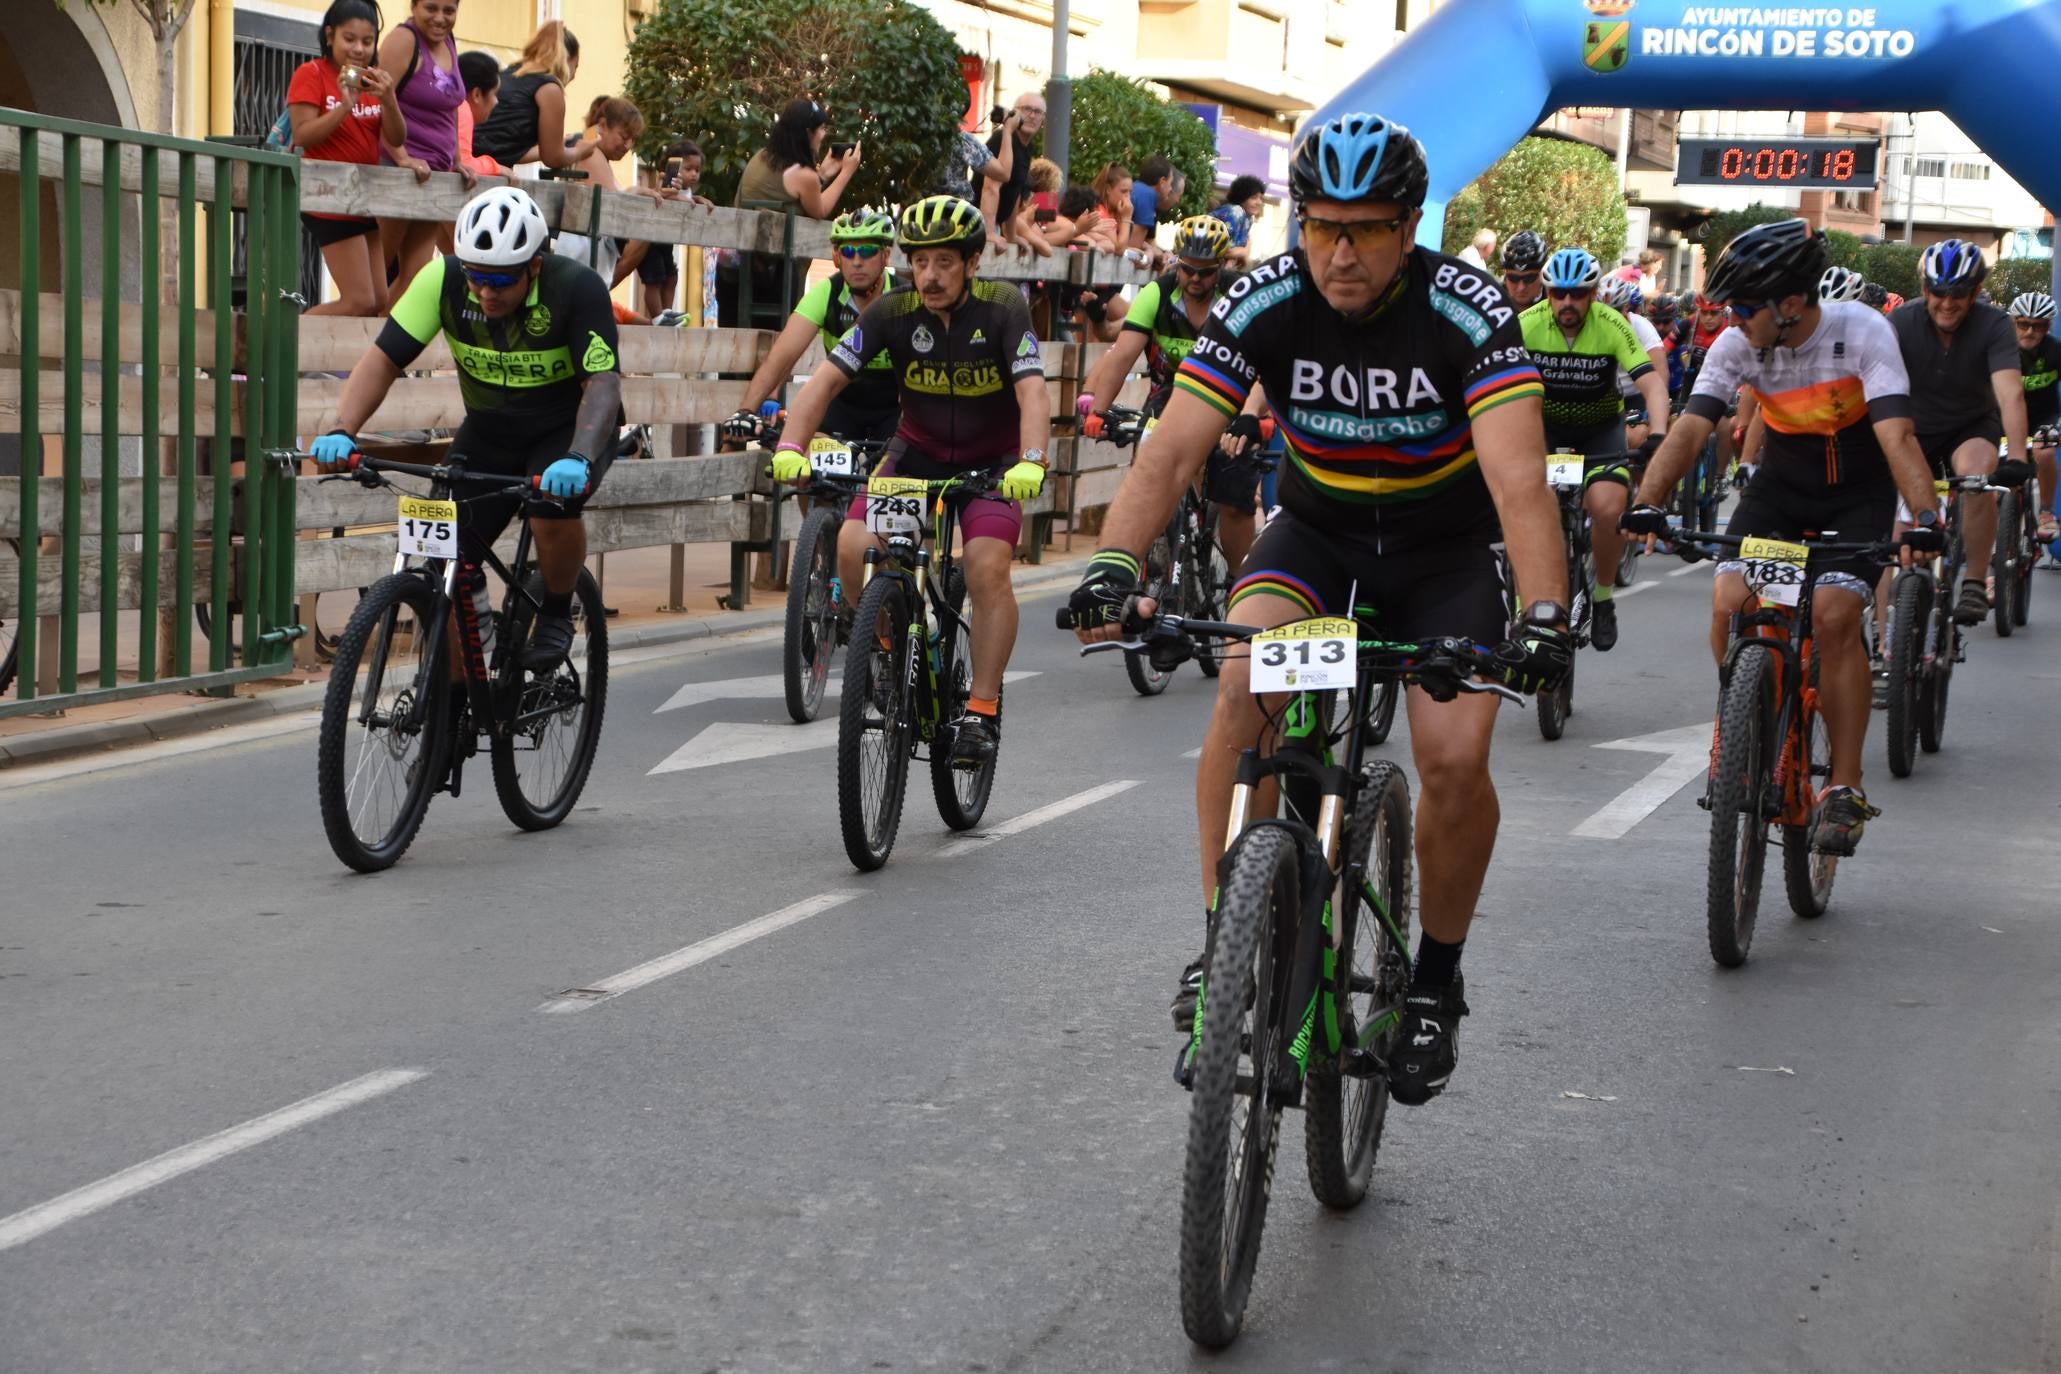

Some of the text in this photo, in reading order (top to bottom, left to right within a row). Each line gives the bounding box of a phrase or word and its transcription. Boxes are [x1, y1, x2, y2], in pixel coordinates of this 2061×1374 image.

[1682, 7, 1875, 26] AYUNTAMIENTO DE
[1641, 28, 1915, 57] RINCÓN DE SOTO
[1212, 256, 1298, 320] BORA
[1435, 264, 1513, 328] BORA
[467, 348, 542, 363] TRAVESIA BTT
[1193, 335, 1255, 379] grohe
[1533, 353, 1559, 367] BAR
[1561, 357, 1608, 369] MATIAS
[1543, 368, 1600, 381] Grávalos
[1290, 359, 1445, 410] BORA
[815, 452, 847, 467] 145
[1555, 464, 1566, 474] 4
[871, 483, 888, 494] LA
[402, 504, 453, 517] LA PERA
[874, 498, 920, 515] 243
[405, 519, 450, 540] 175
[1744, 543, 1763, 554] LA
[1293, 622, 1350, 636] PERA
[1261, 640, 1346, 666] 313
[908, 638, 920, 688] FOX
